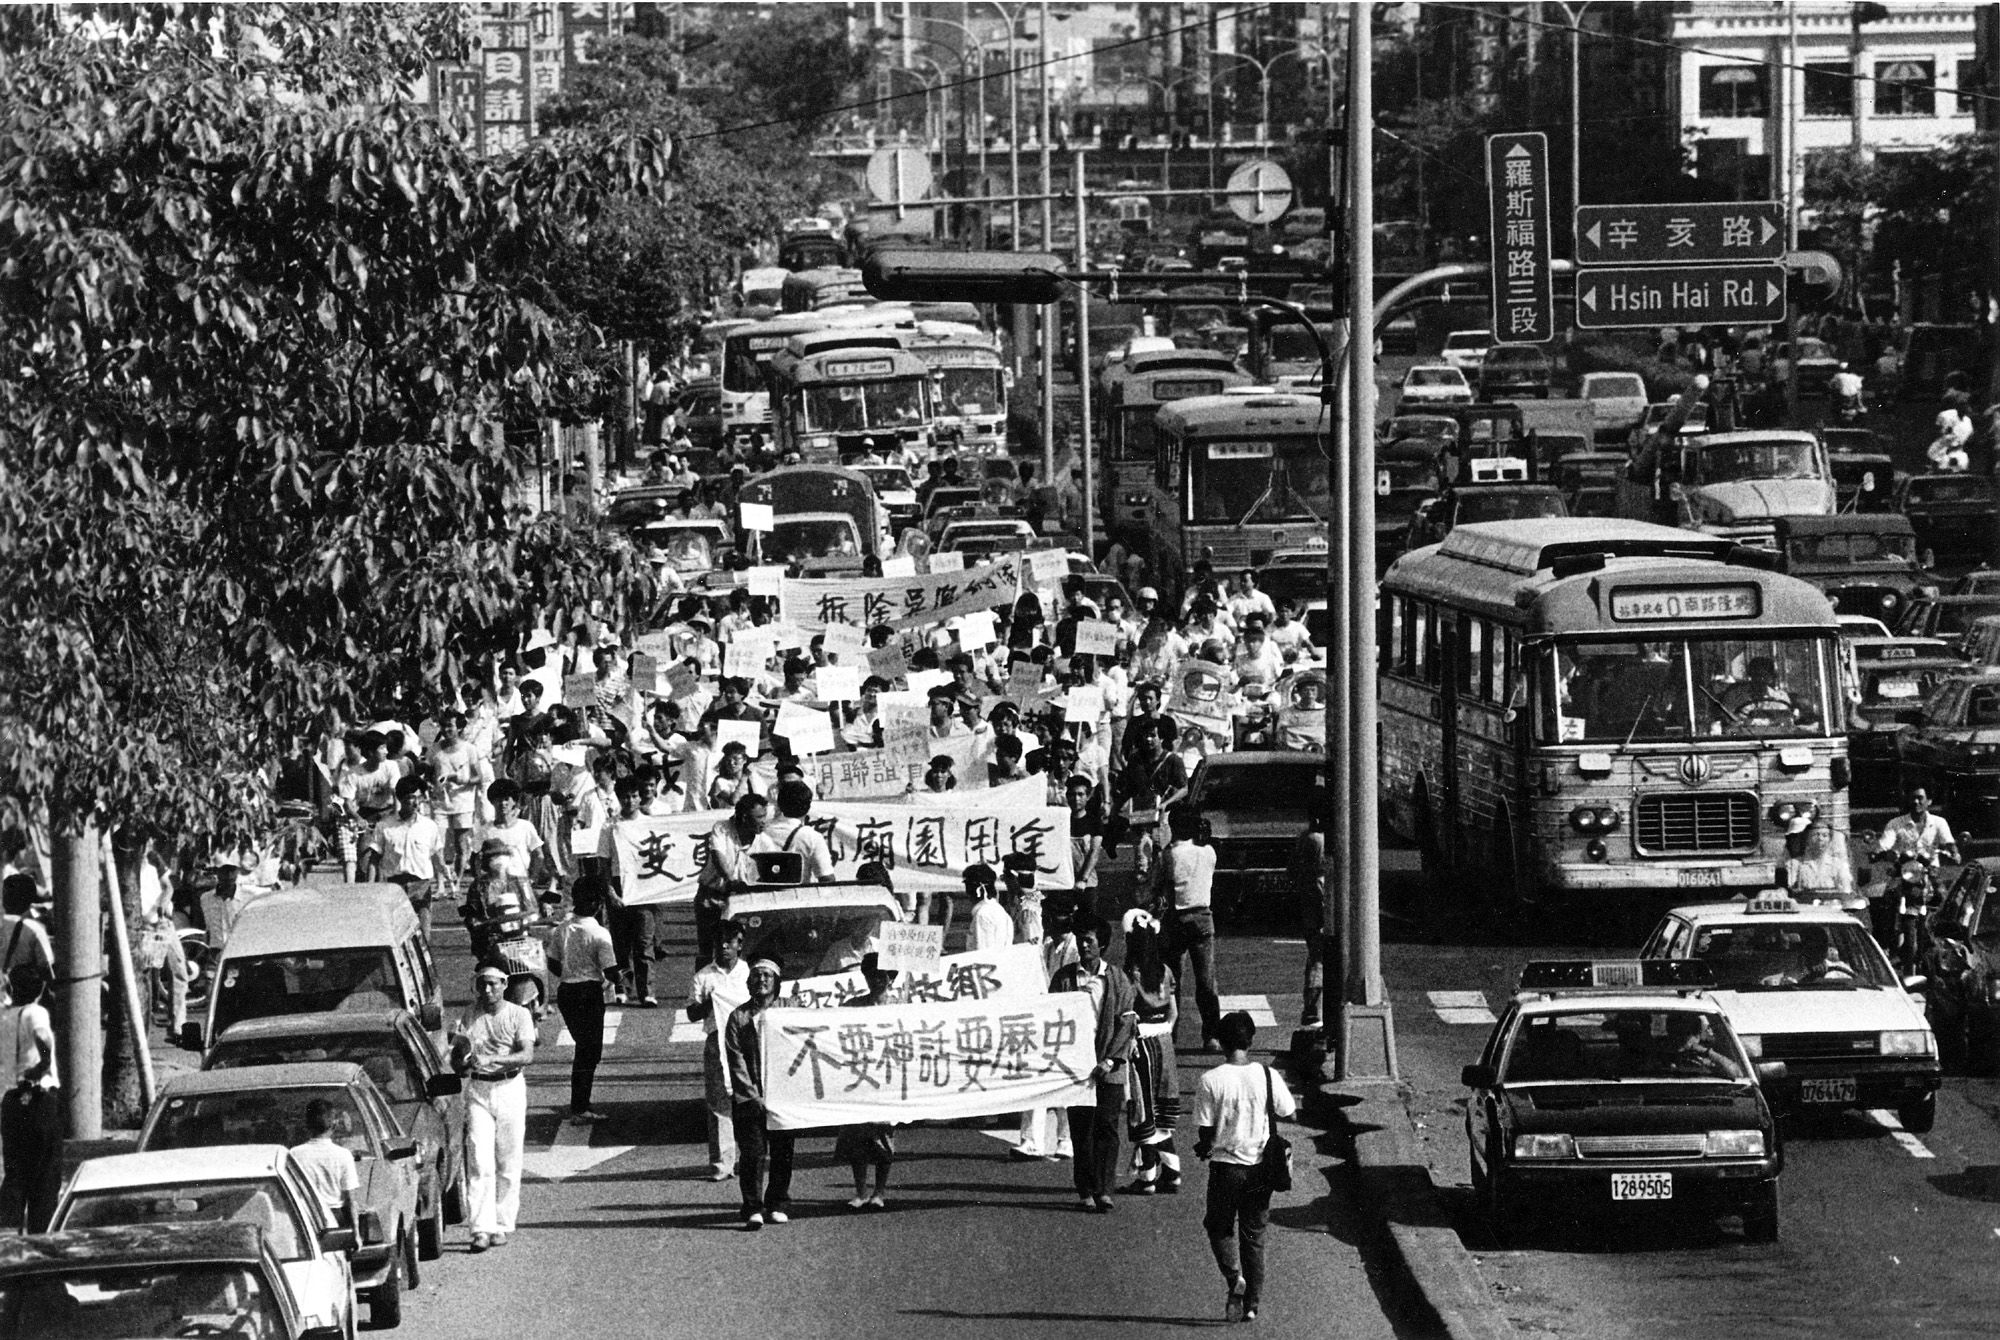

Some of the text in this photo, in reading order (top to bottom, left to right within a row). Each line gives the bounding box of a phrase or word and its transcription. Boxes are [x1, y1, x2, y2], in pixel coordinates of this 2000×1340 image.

[1504, 159, 1538, 334] 羅斯福路三段
[1608, 215, 1754, 250] 辛亥路
[1610, 284, 1662, 311] Hsin
[1672, 282, 1710, 309] Hai
[783, 1009, 1087, 1101] 不要神話要歷史
